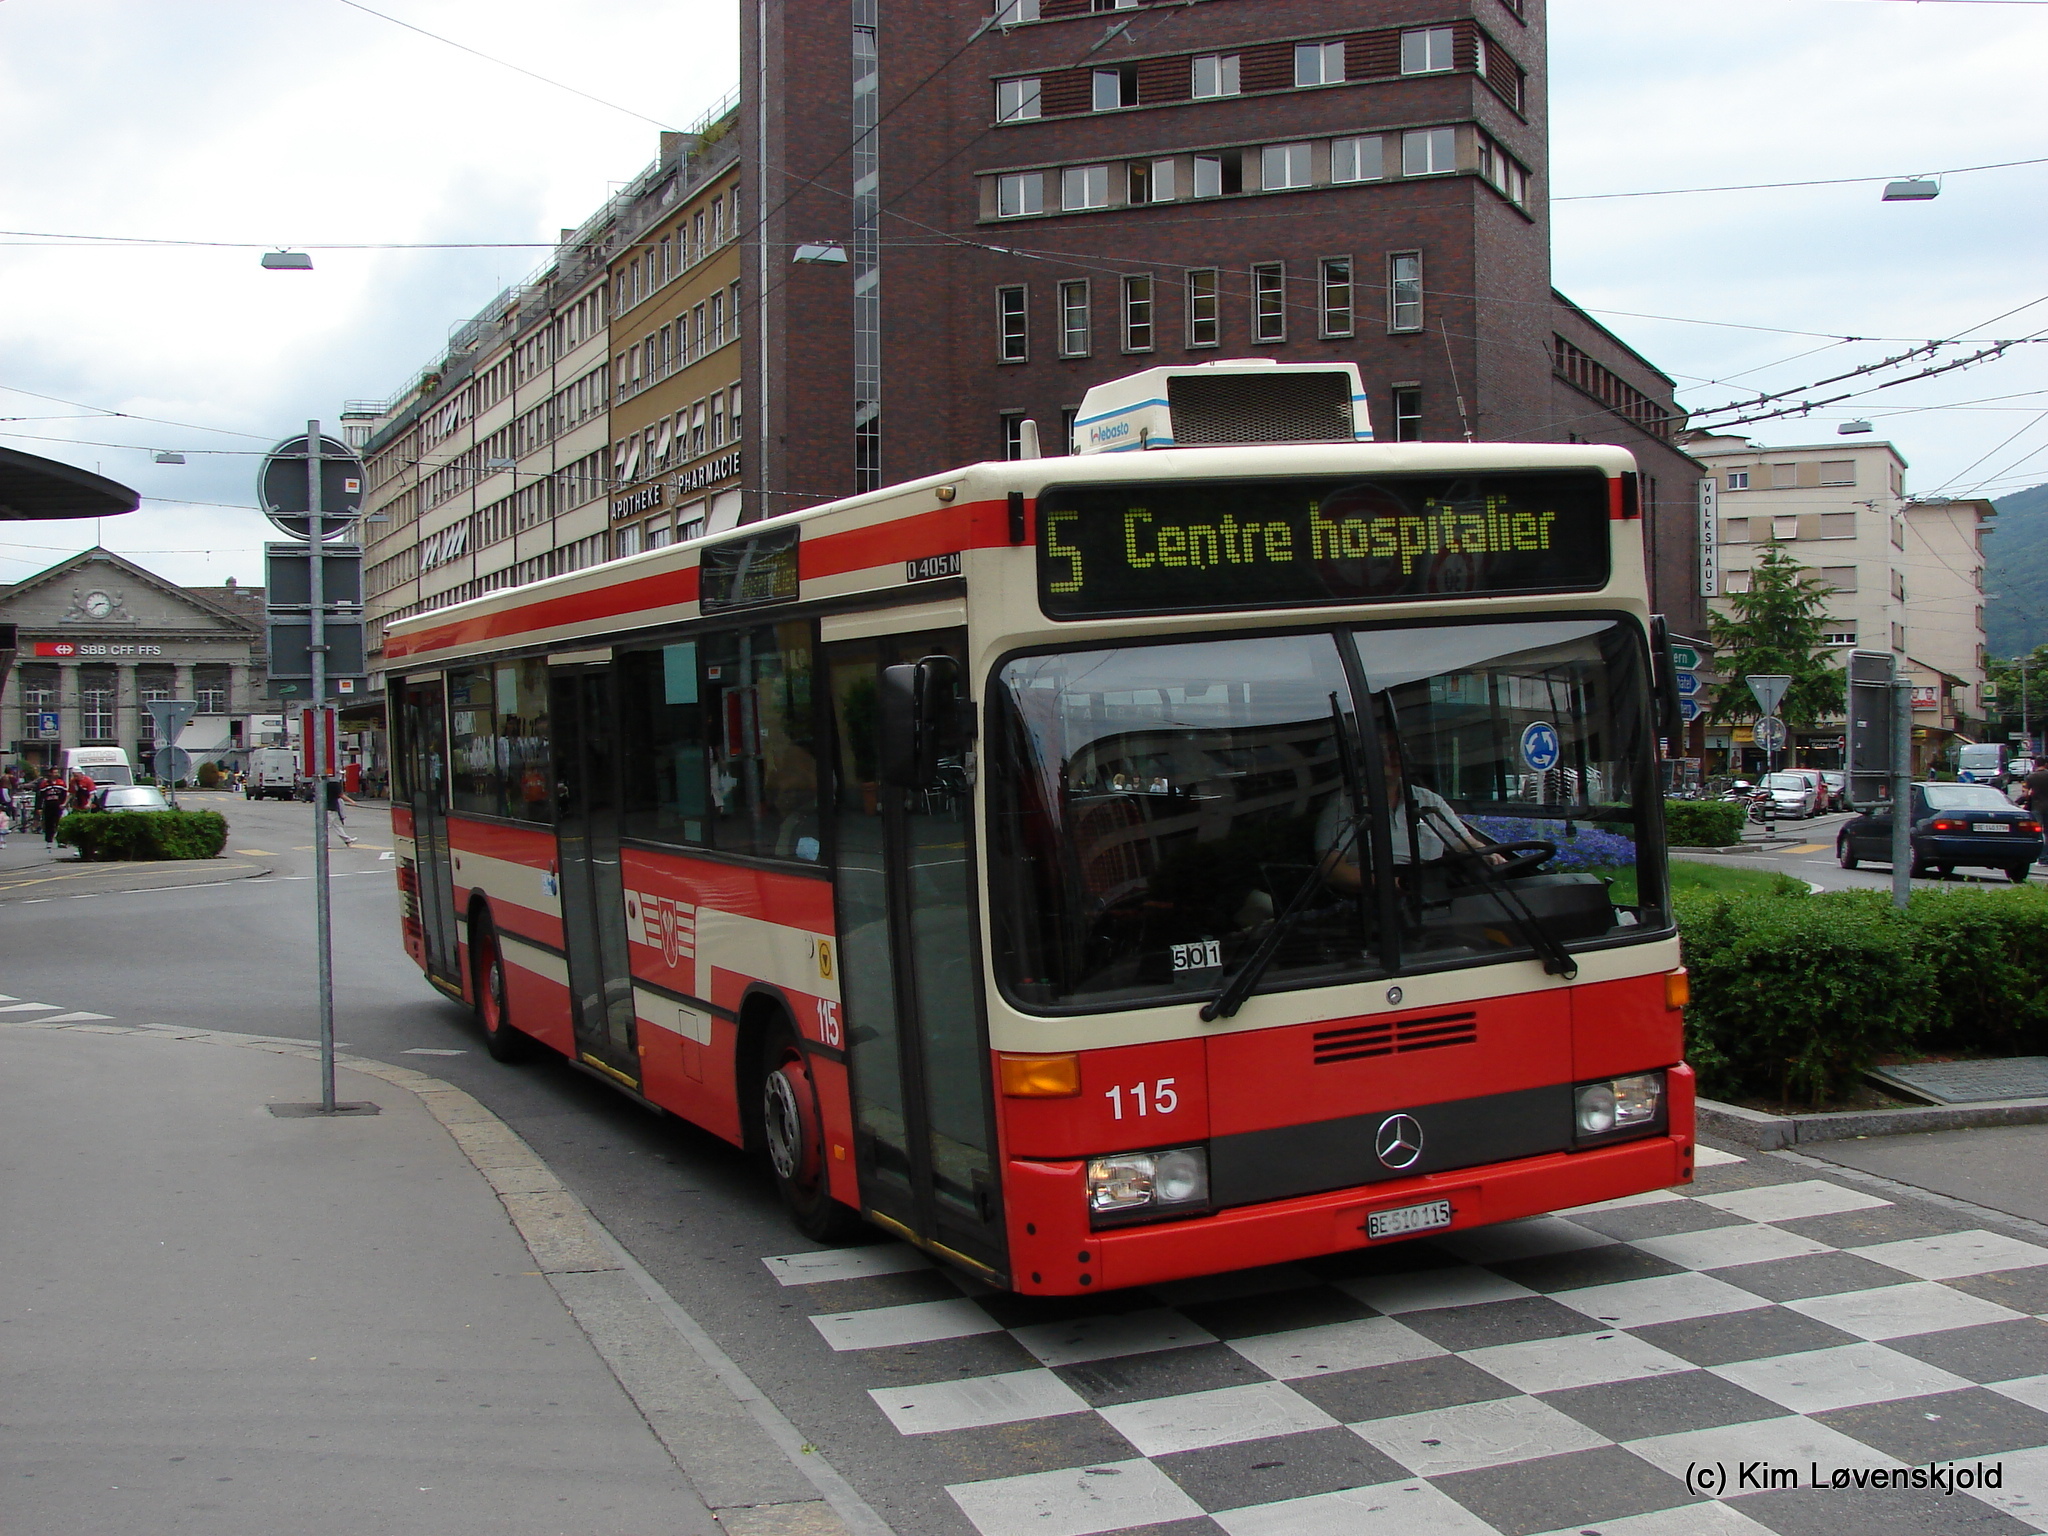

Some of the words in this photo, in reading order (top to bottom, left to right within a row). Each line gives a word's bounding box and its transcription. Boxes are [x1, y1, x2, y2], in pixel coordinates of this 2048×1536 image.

[1091, 422, 1129, 443] Webasto
[611, 485, 660, 520] APOTHEKE
[678, 451, 741, 494] PHARMACIE
[1048, 510, 1083, 593] 5
[1124, 508, 1293, 569] Centre
[1309, 495, 1556, 575] hospitalier
[1703, 483, 1713, 592] VOLKSHAUS
[919, 555, 948, 577] 405
[950, 553, 960, 572] N
[80, 645, 107, 655] SBB
[111, 645, 134, 655] CFF
[138, 645, 161, 655] FFS
[1673, 652, 1688, 664] ern
[1173, 947, 1219, 969] 501
[816, 998, 839, 1046] 115
[1105, 1077, 1178, 1120] 115
